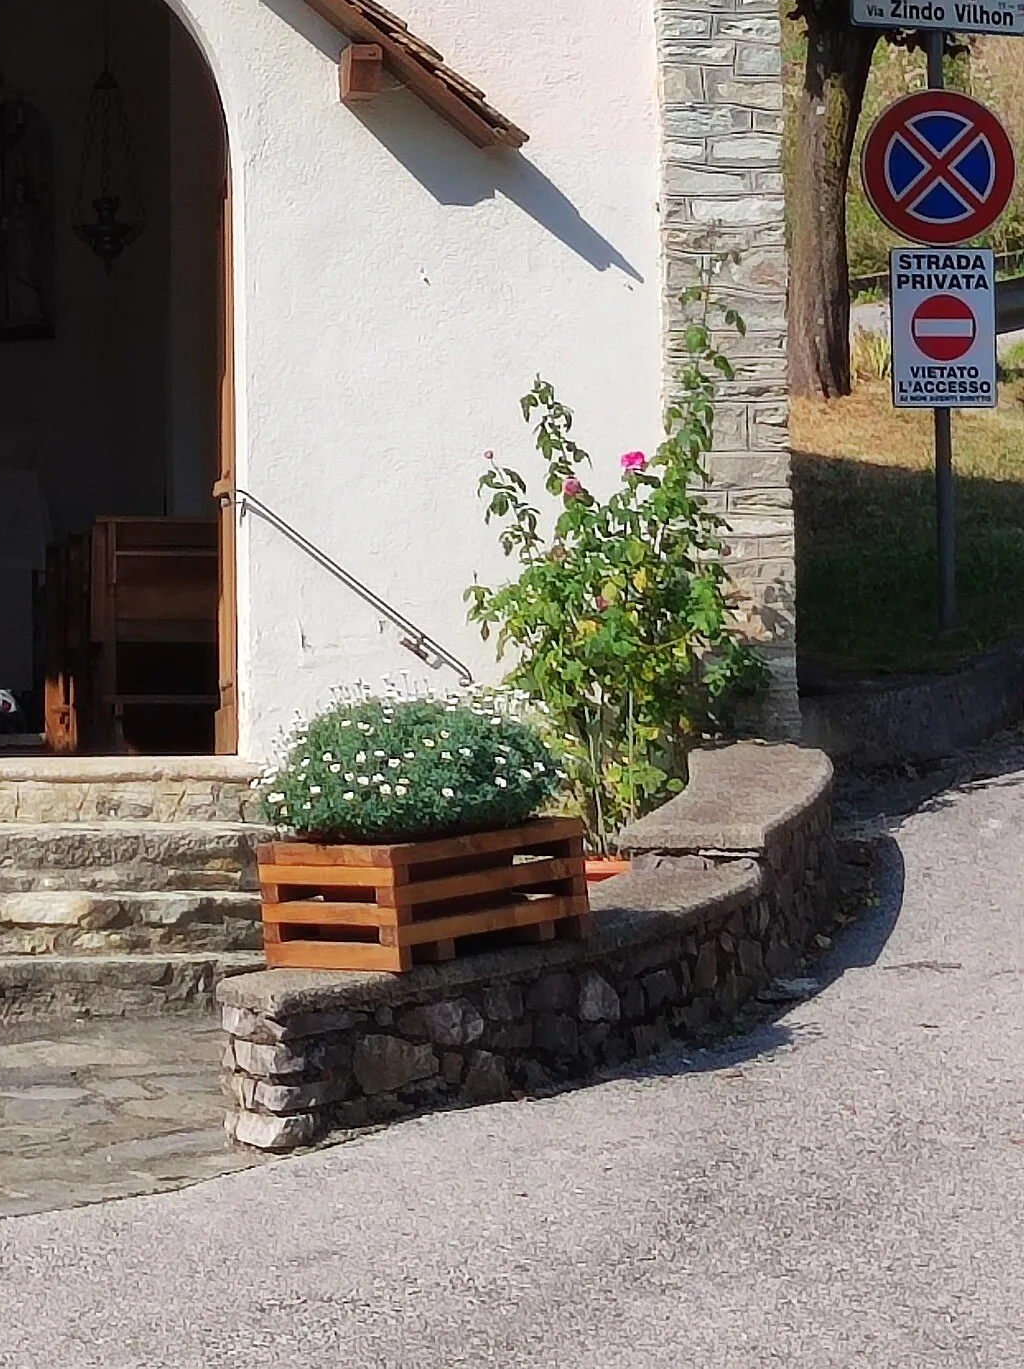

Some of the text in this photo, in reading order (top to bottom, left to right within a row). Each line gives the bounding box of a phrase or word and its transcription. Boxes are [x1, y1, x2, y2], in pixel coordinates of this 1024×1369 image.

[866, 3, 884, 18] Via
[890, 0, 945, 21] Zindo
[954, 3, 1014, 26] Vilhon
[898, 253, 986, 271] STRADA
[896, 273, 989, 290] PRIVATA
[910, 366, 980, 379] VIETATO
[898, 380, 992, 394] L'ACCESSO
